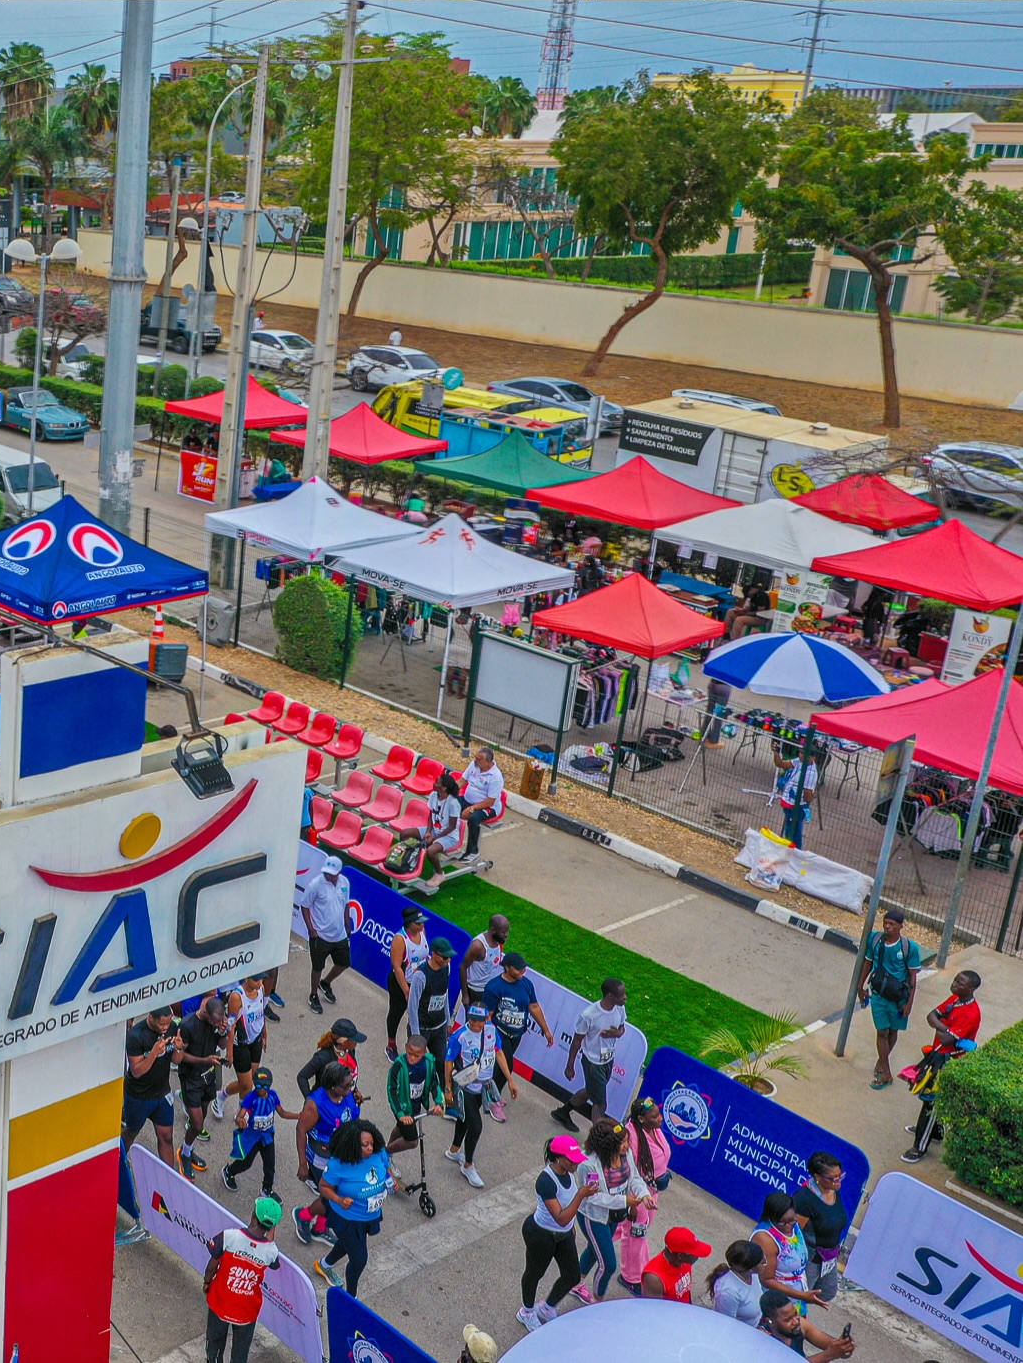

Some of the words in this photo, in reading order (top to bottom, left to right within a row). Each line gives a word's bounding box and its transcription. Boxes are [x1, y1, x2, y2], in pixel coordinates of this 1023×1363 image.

[631, 427, 673, 443] SANEAMENTO
[632, 418, 660, 432] RECOLHA
[660, 425, 670, 434] DE
[671, 426, 703, 439] RESÍDUOS
[629, 437, 657, 449] LIMPEZA
[657, 442, 665, 451] DE
[665, 444, 696, 457] TANQUES
[86, 564, 145, 581] ANGOLAUTO
[362, 569, 406, 589] MOVA-SE
[497, 582, 539, 597] MOVA-SE
[67, 596, 117, 614] ANGOLAUTO
[962, 633, 992, 647] KONDY
[60, 1009, 80, 1026] DE
[84, 977, 177, 1020] ATENDIMENTO
[178, 970, 198, 988] AO
[199, 951, 254, 980] CIDADÃO
[732, 1123, 807, 1172] ADMINISTRA
[724, 1148, 787, 1194] TALATONA
[727, 1135, 794, 1181] MUNICIPAL
[797, 1174, 807, 1187] D
[896, 1247, 1023, 1349] SIA
[890, 1283, 920, 1304] SERVIÇO
[920, 1301, 962, 1330] INTEGRADO
[961, 1326, 974, 1337] DE
